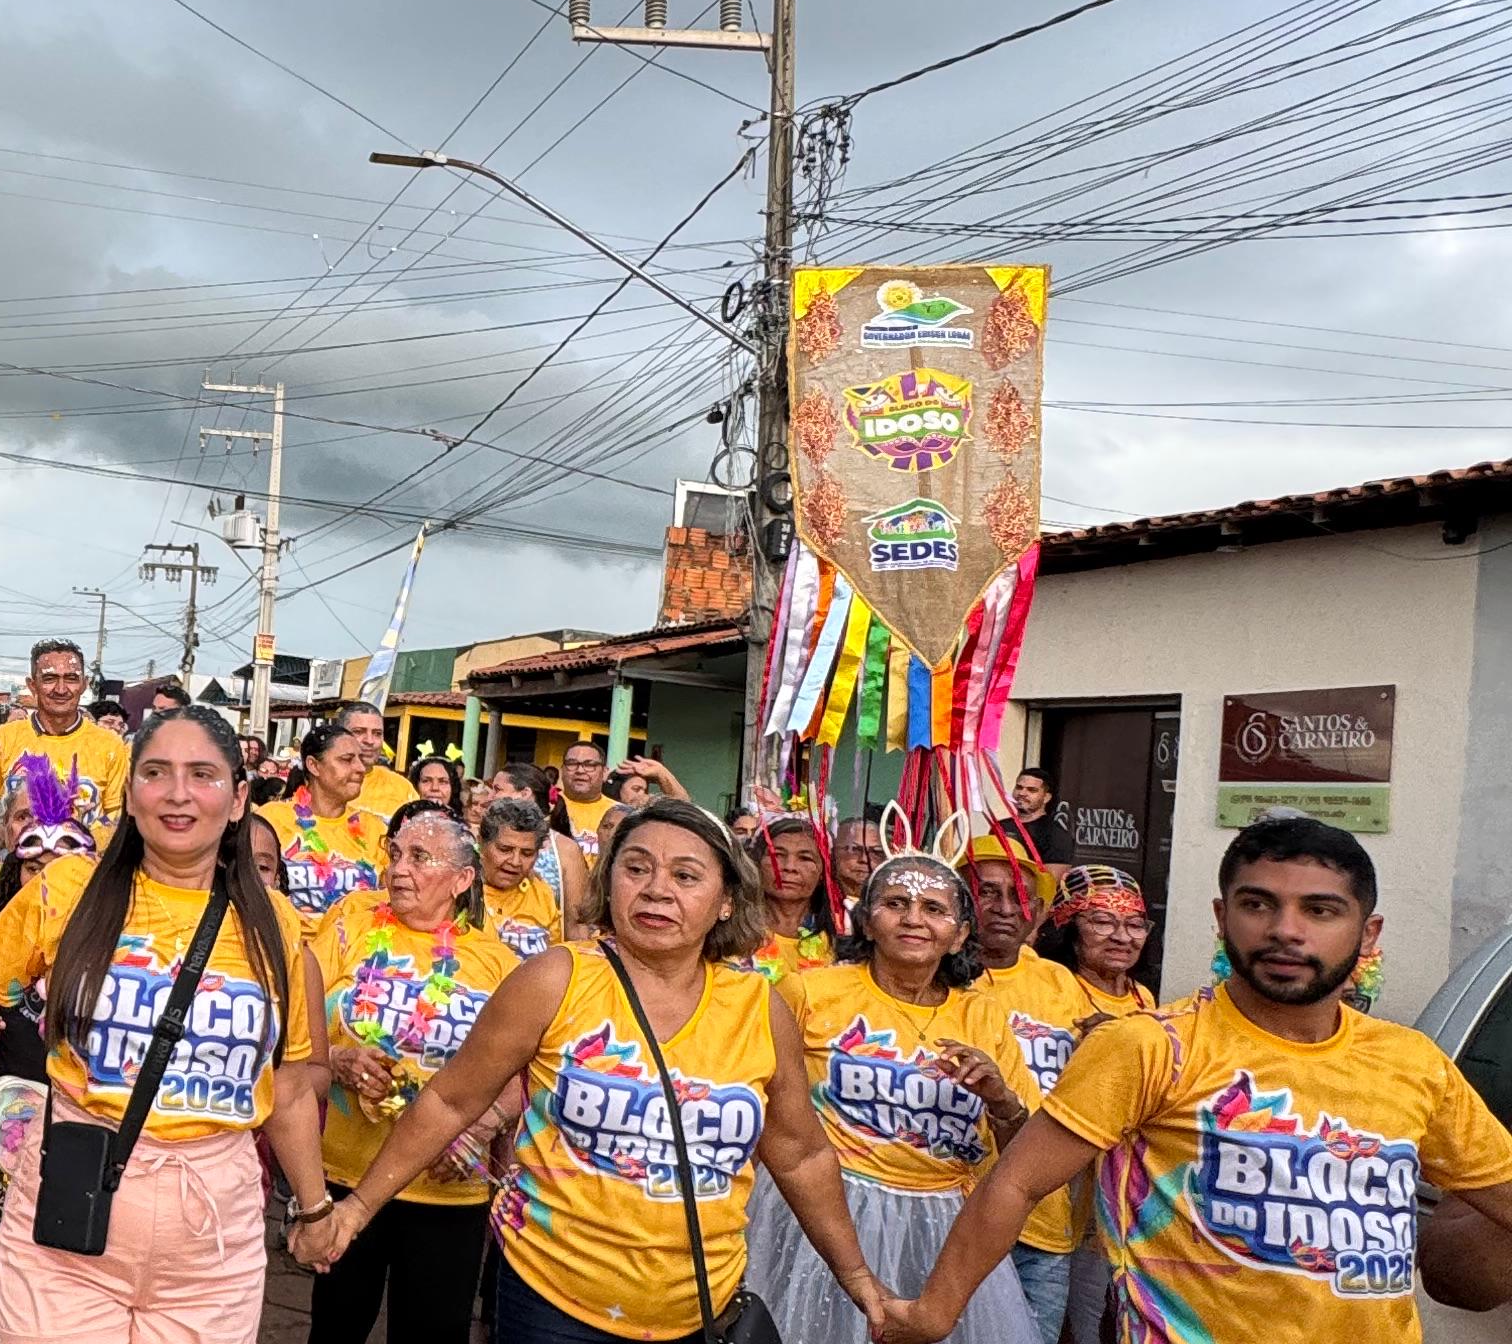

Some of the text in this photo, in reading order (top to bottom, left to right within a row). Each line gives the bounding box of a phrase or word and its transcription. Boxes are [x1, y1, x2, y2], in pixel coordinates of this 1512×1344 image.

[864, 410, 959, 437] IDOSO
[872, 540, 957, 563] SEDES
[1279, 714, 1368, 732] SANTOS &
[1278, 729, 1376, 749] CARNEIRO
[1076, 807, 1135, 829] SANTOS &
[1076, 826, 1139, 849] CARNEIRO
[161, 1074, 252, 1115] 2026
[1215, 1141, 1416, 1209] BLOCO
[1211, 1199, 1412, 1252] DO IDOSO
